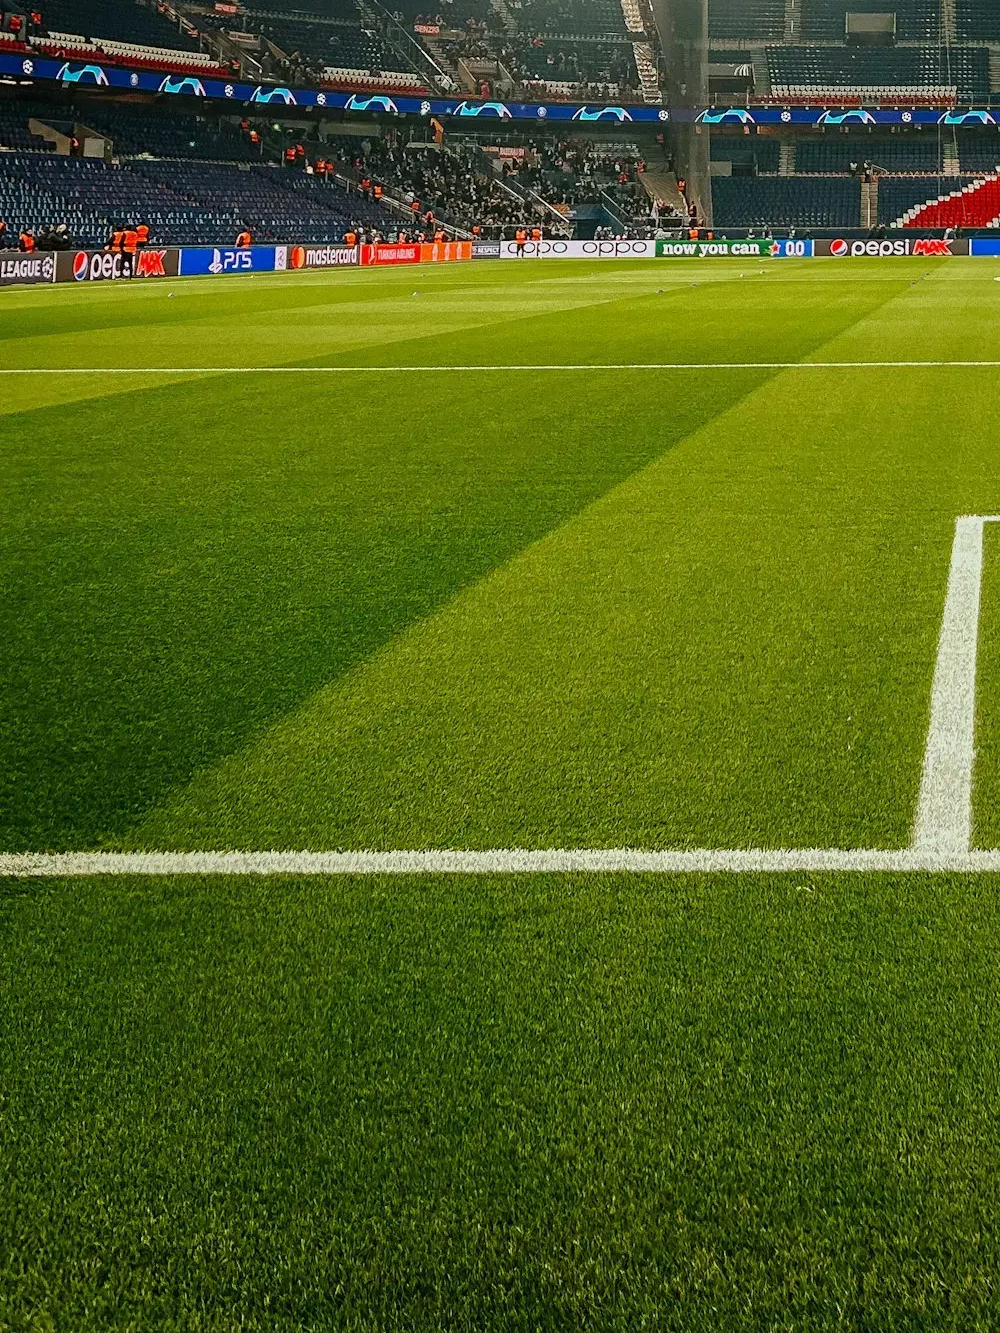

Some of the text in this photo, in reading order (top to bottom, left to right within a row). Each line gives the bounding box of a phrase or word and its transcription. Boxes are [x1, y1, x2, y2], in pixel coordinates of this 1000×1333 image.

[306, 245, 358, 266] mastercard
[477, 246, 499, 254] RESPECT
[507, 241, 568, 257] oppo
[582, 241, 647, 257] oppo
[663, 243, 760, 258] now you can
[785, 241, 805, 256] 0.0
[851, 238, 954, 257] pepsi MAX
[136, 250, 167, 278] MAX
[223, 251, 252, 269] PS5
[0, 260, 41, 278] LEAGUE
